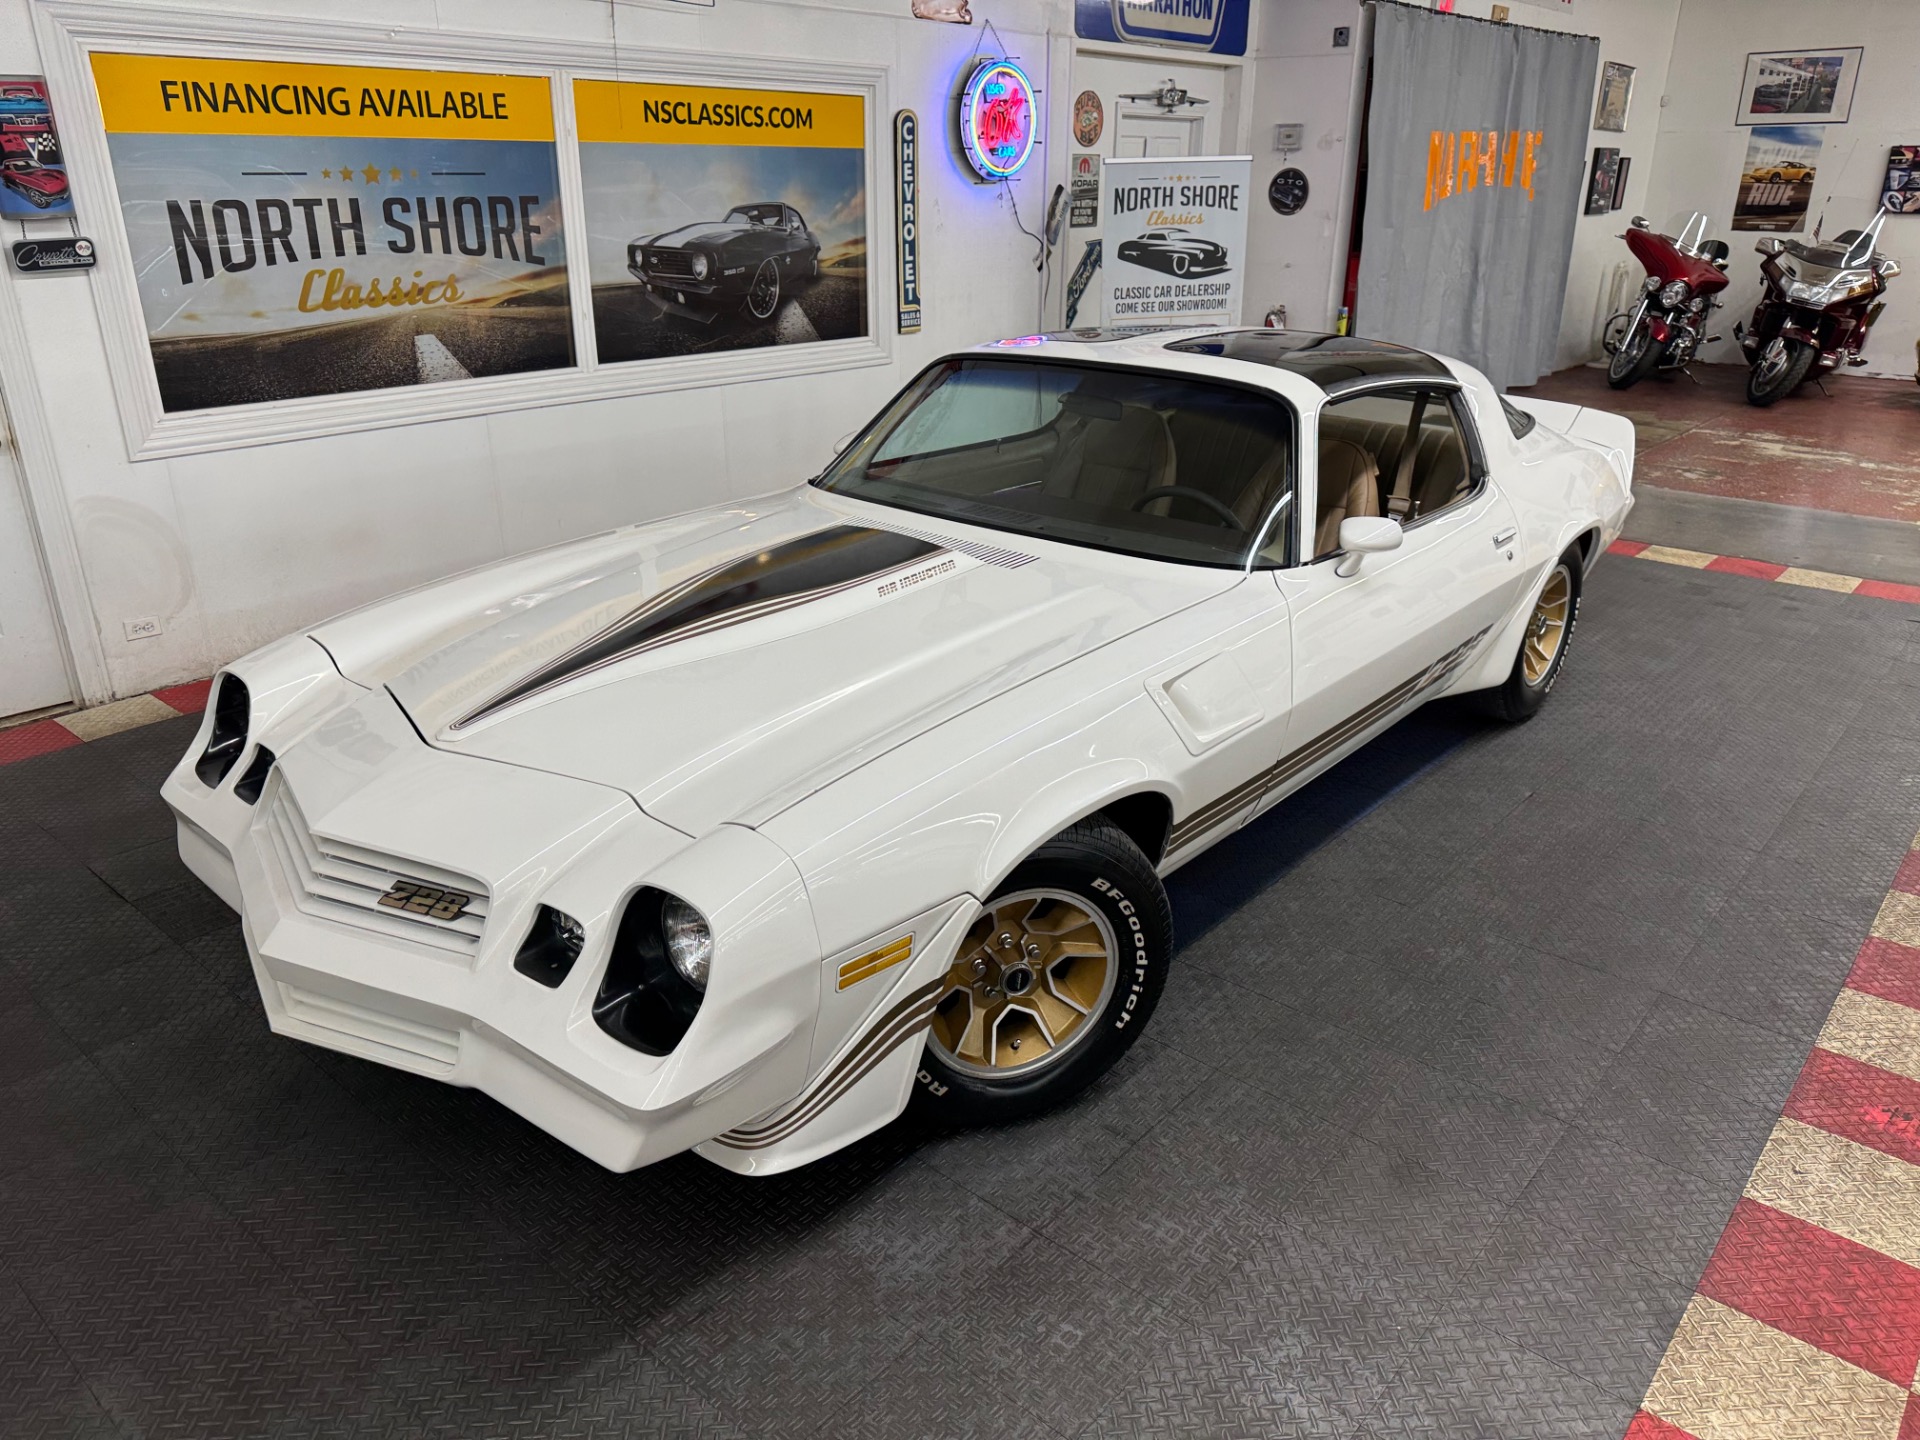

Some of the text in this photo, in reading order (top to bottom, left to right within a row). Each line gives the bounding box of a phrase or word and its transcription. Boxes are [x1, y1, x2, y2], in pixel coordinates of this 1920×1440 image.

[1127, 0, 1213, 20] RATHON
[160, 80, 509, 120] FINANCING AVAILABLE
[985, 83, 1006, 95] USED
[643, 99, 813, 130] NSCLASSICS.COM
[1075, 93, 1100, 119] SUPER
[1080, 124, 1099, 144] BEE
[1071, 179, 1099, 188] MOPAR
[1277, 177, 1304, 186] GTO
[1114, 185, 1240, 215] NORTH SHORE
[1745, 182, 1799, 206] RIDE
[902, 121, 916, 301] CHEVROLET
[1146, 210, 1205, 226] Classics
[165, 195, 546, 286] NORTH SHORE
[17, 245, 79, 266] Corvette
[298, 268, 465, 314] Classics
[1072, 260, 1093, 299] Ford
[1114, 283, 1231, 300] CLASSIC CAR DEALERSHIP
[901, 312, 916, 320] SALES
[1115, 298, 1227, 314] COME SEE OUR SHOWROOM!
[901, 318, 921, 327] SERVICE
[877, 559, 957, 597] AIR INDUCTION
[377, 879, 470, 921] Z28
[1090, 877, 1148, 1030] BFGoodrich
